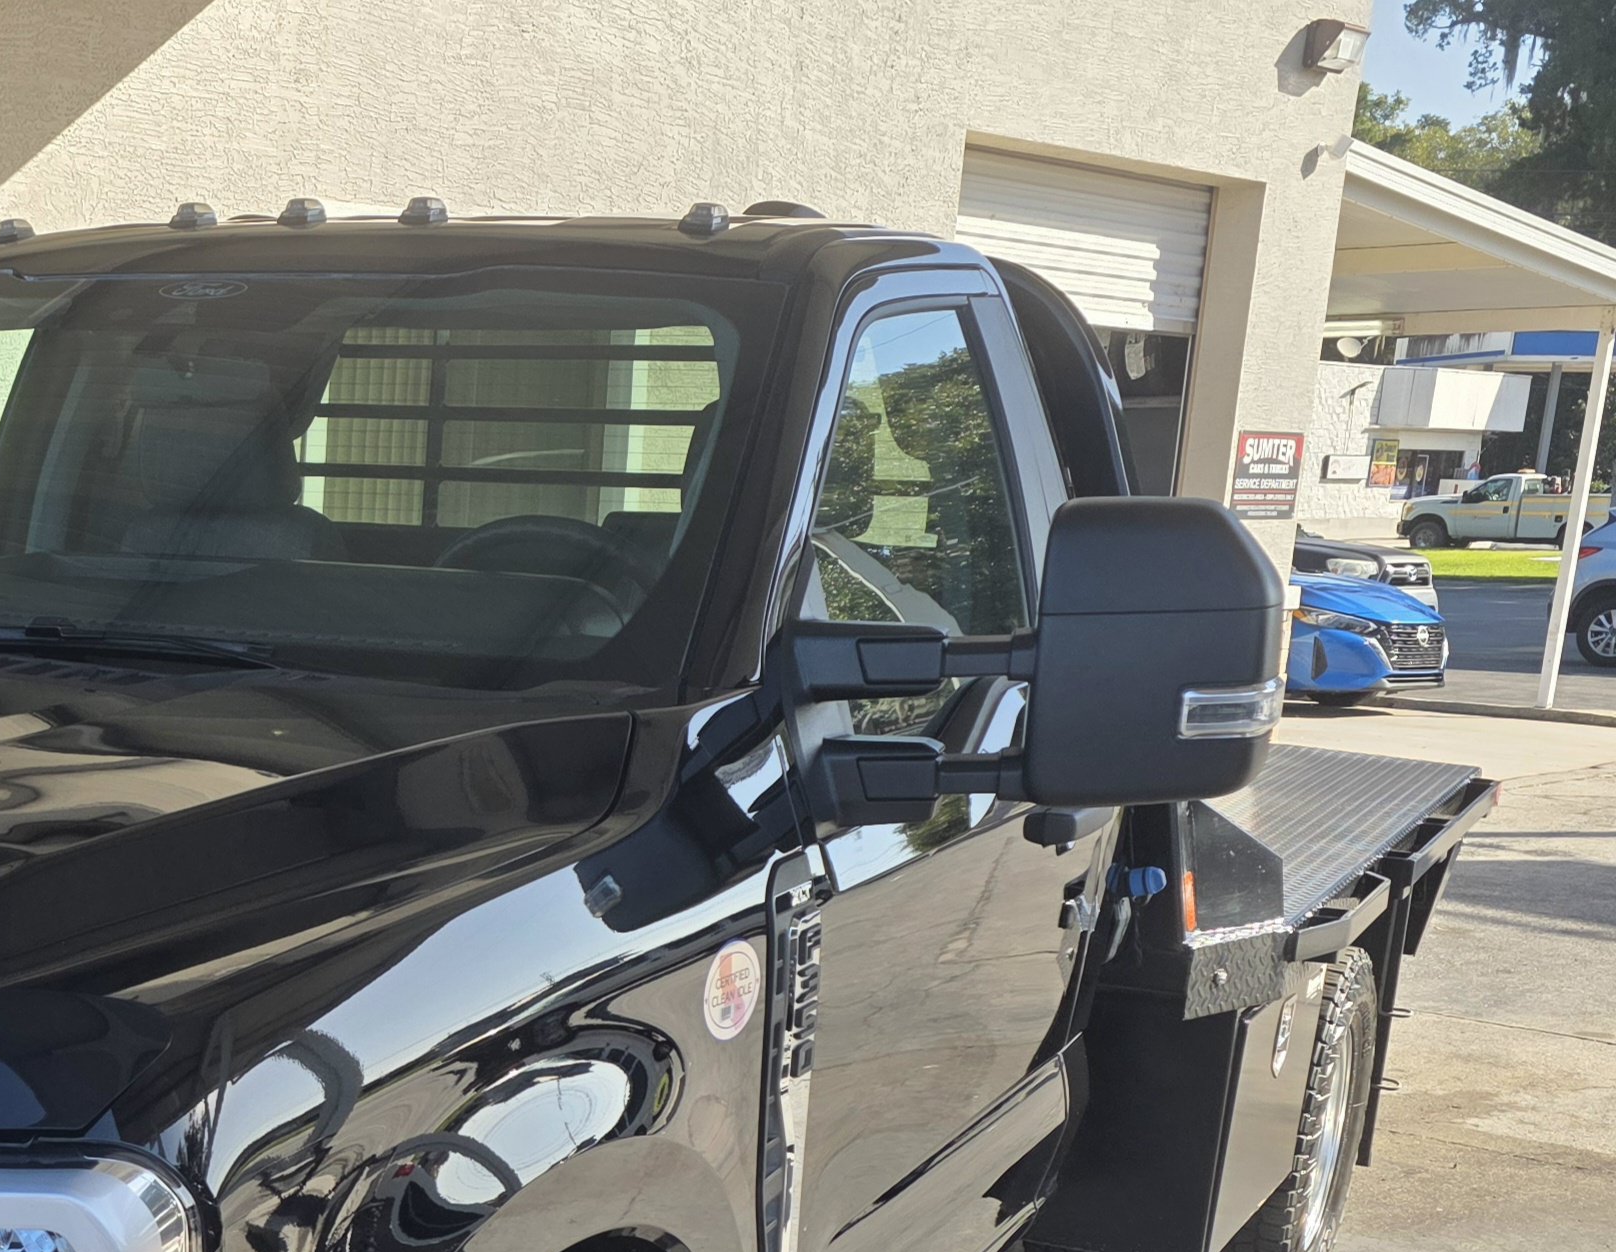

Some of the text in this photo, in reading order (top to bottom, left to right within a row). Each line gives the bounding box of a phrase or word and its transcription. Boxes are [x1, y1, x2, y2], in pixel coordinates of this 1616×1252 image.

[1243, 438, 1296, 466] SUMTER
[1235, 478, 1297, 489] SERVICE DEPARTMENT
[716, 967, 751, 990] CERTIFIED
[711, 982, 752, 1008] CLEAN IDLE
